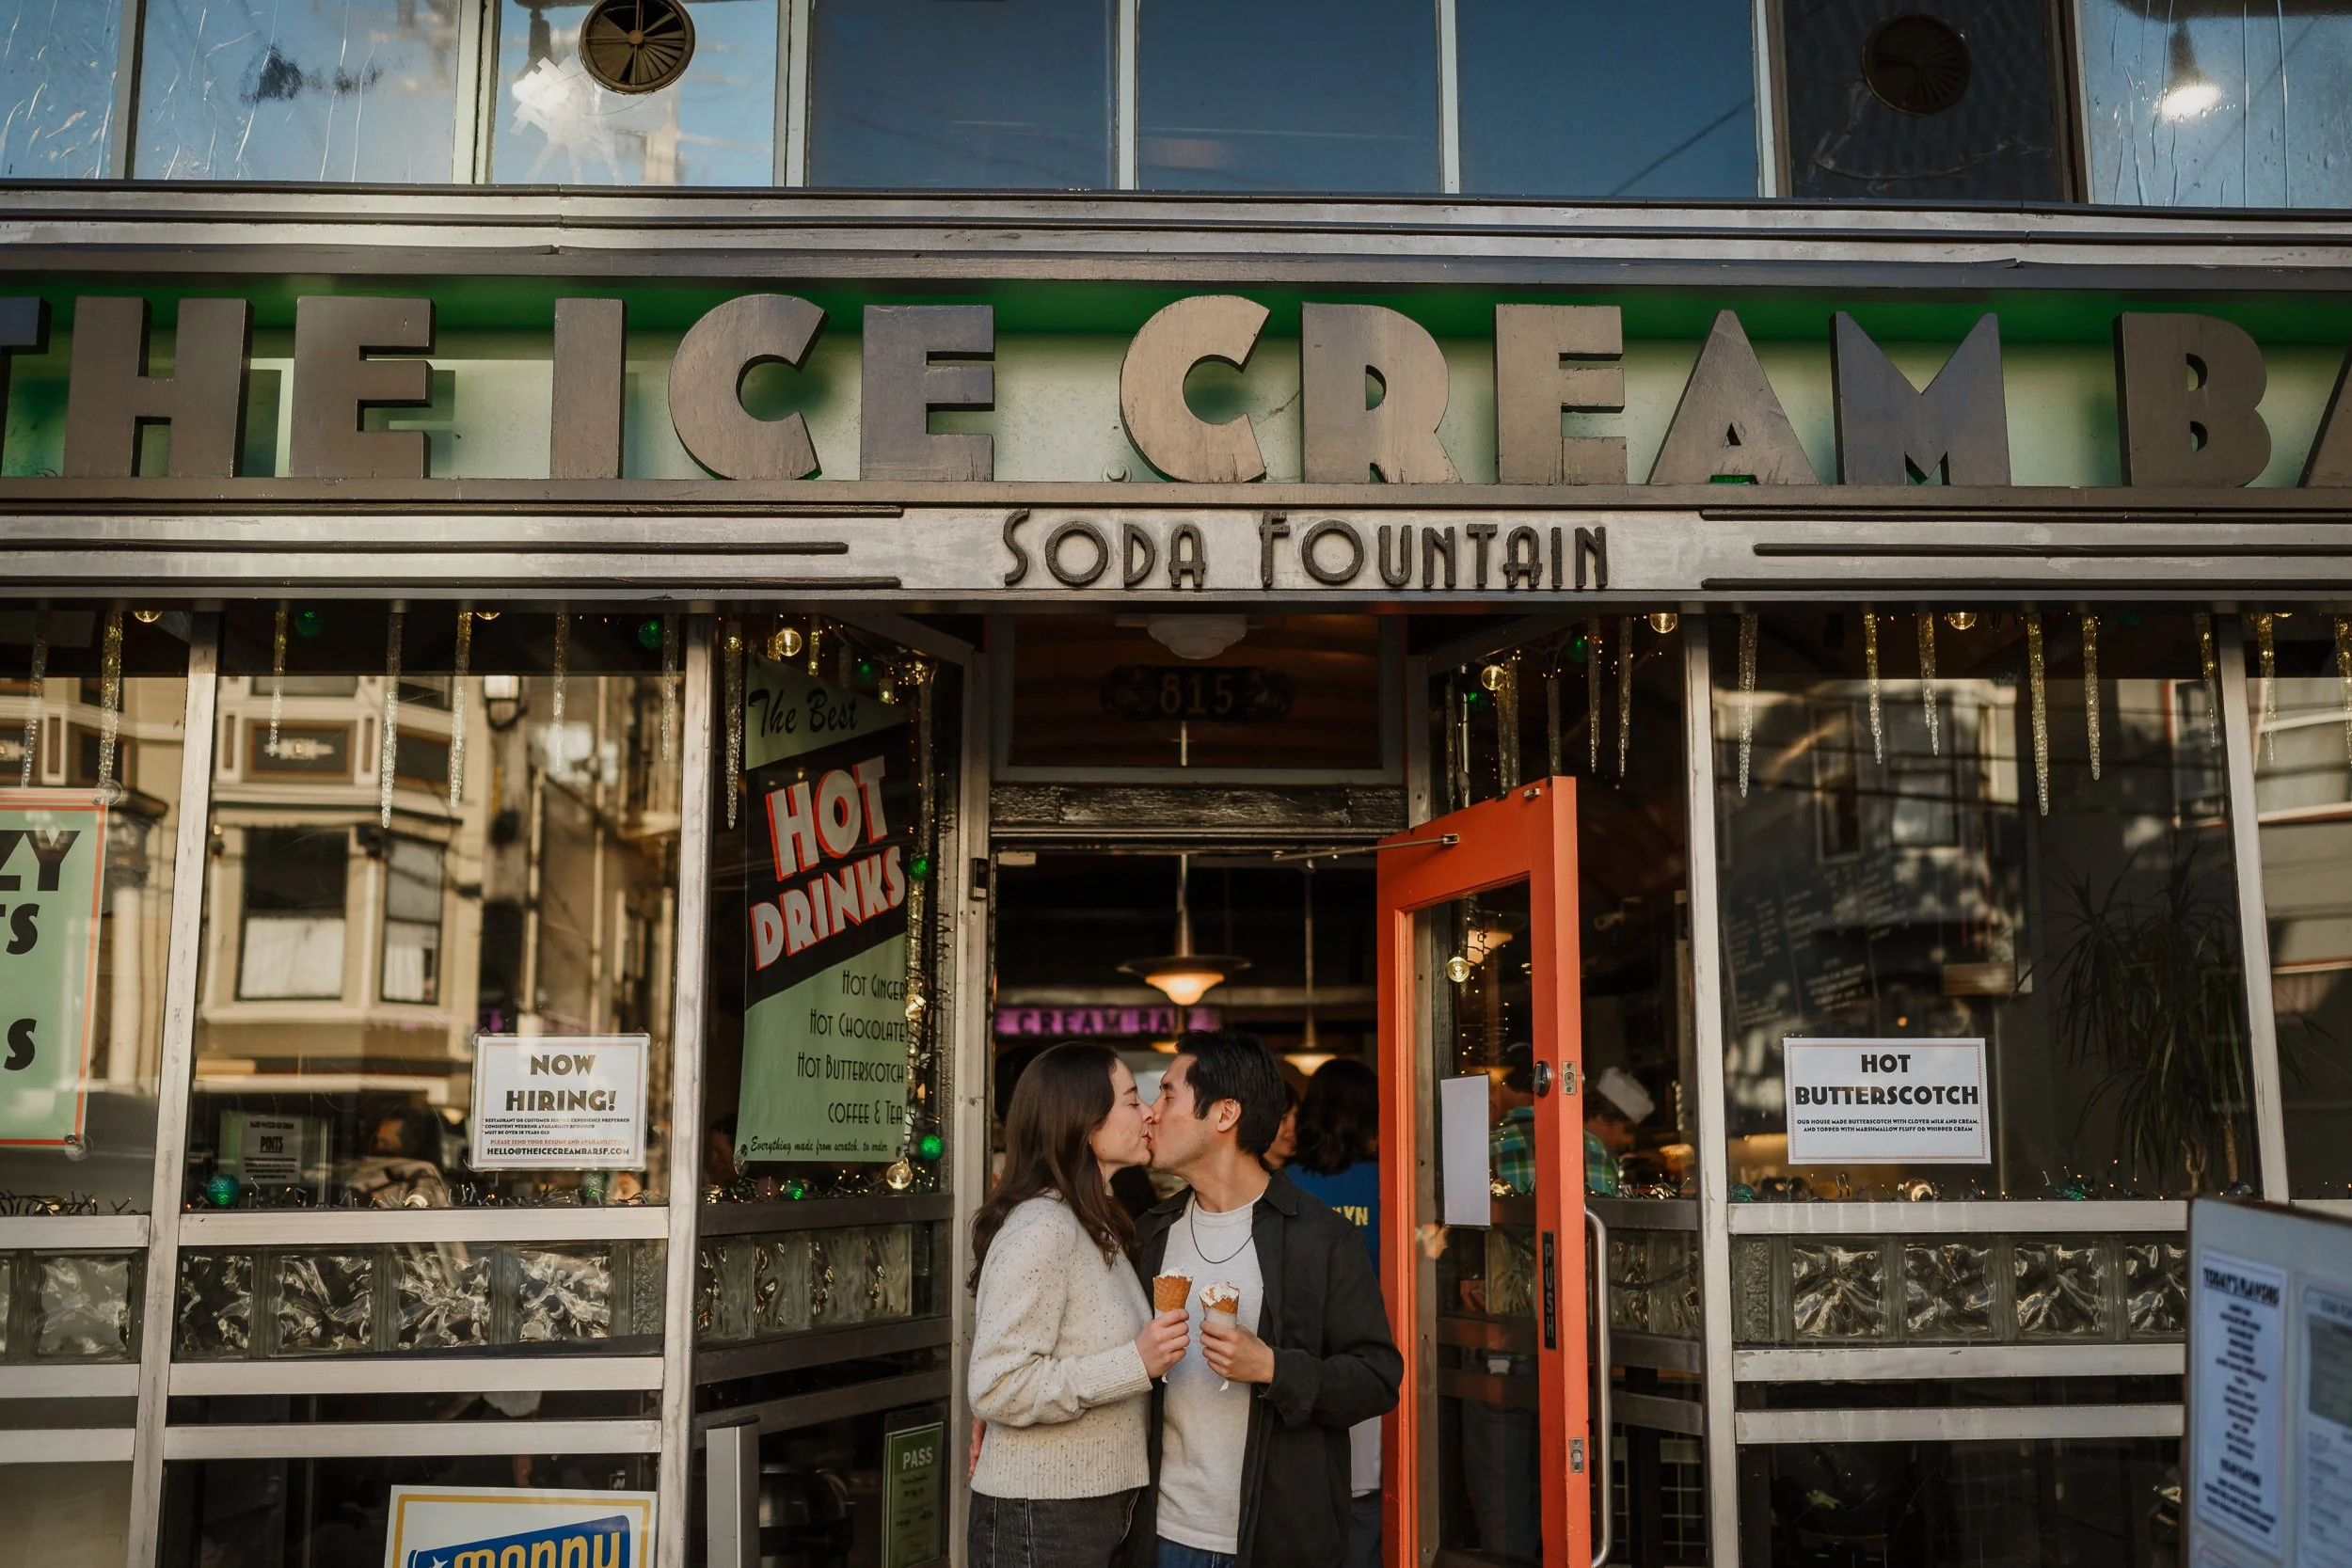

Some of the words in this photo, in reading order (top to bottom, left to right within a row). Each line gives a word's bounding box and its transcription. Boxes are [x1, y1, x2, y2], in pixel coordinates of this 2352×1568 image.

[551, 293, 996, 482] ICE
[1120, 294, 2011, 486] CREAM
[1003, 509, 1206, 589] SODA
[1259, 511, 1609, 589] FOUNTAIN
[1160, 673, 1234, 715] 815
[748, 688, 798, 737] The
[806, 688, 858, 733] Best
[765, 754, 888, 881] HOT
[750, 846, 906, 971] DRINKS
[0, 903, 40, 955] S
[871, 974, 906, 1001] GINGER
[839, 1013, 905, 1043] CHOCOLATE
[531, 1053, 596, 1076] NOW
[826, 1054, 904, 1084] BUTTERSCOTCH
[1861, 1053, 1911, 1073] HOT
[505, 1089, 616, 1112] HIRING!
[1794, 1085, 1979, 1105] BUTTERSCOTCH
[828, 1102, 869, 1124] COFFEE
[874, 1100, 881, 1125] &
[260, 1135, 283, 1153] PINTS
[486, 1148, 630, 1156] HELLO@THEICECREAMBARSF.COM
[751, 1136, 792, 1155] Everything
[794, 1139, 814, 1151] made
[816, 1139, 832, 1156] from
[863, 1141, 869, 1151] to
[1331, 1206, 1368, 1226] YN
[1545, 1243, 1554, 1338] PUSH
[903, 1446, 933, 1470] PASS
